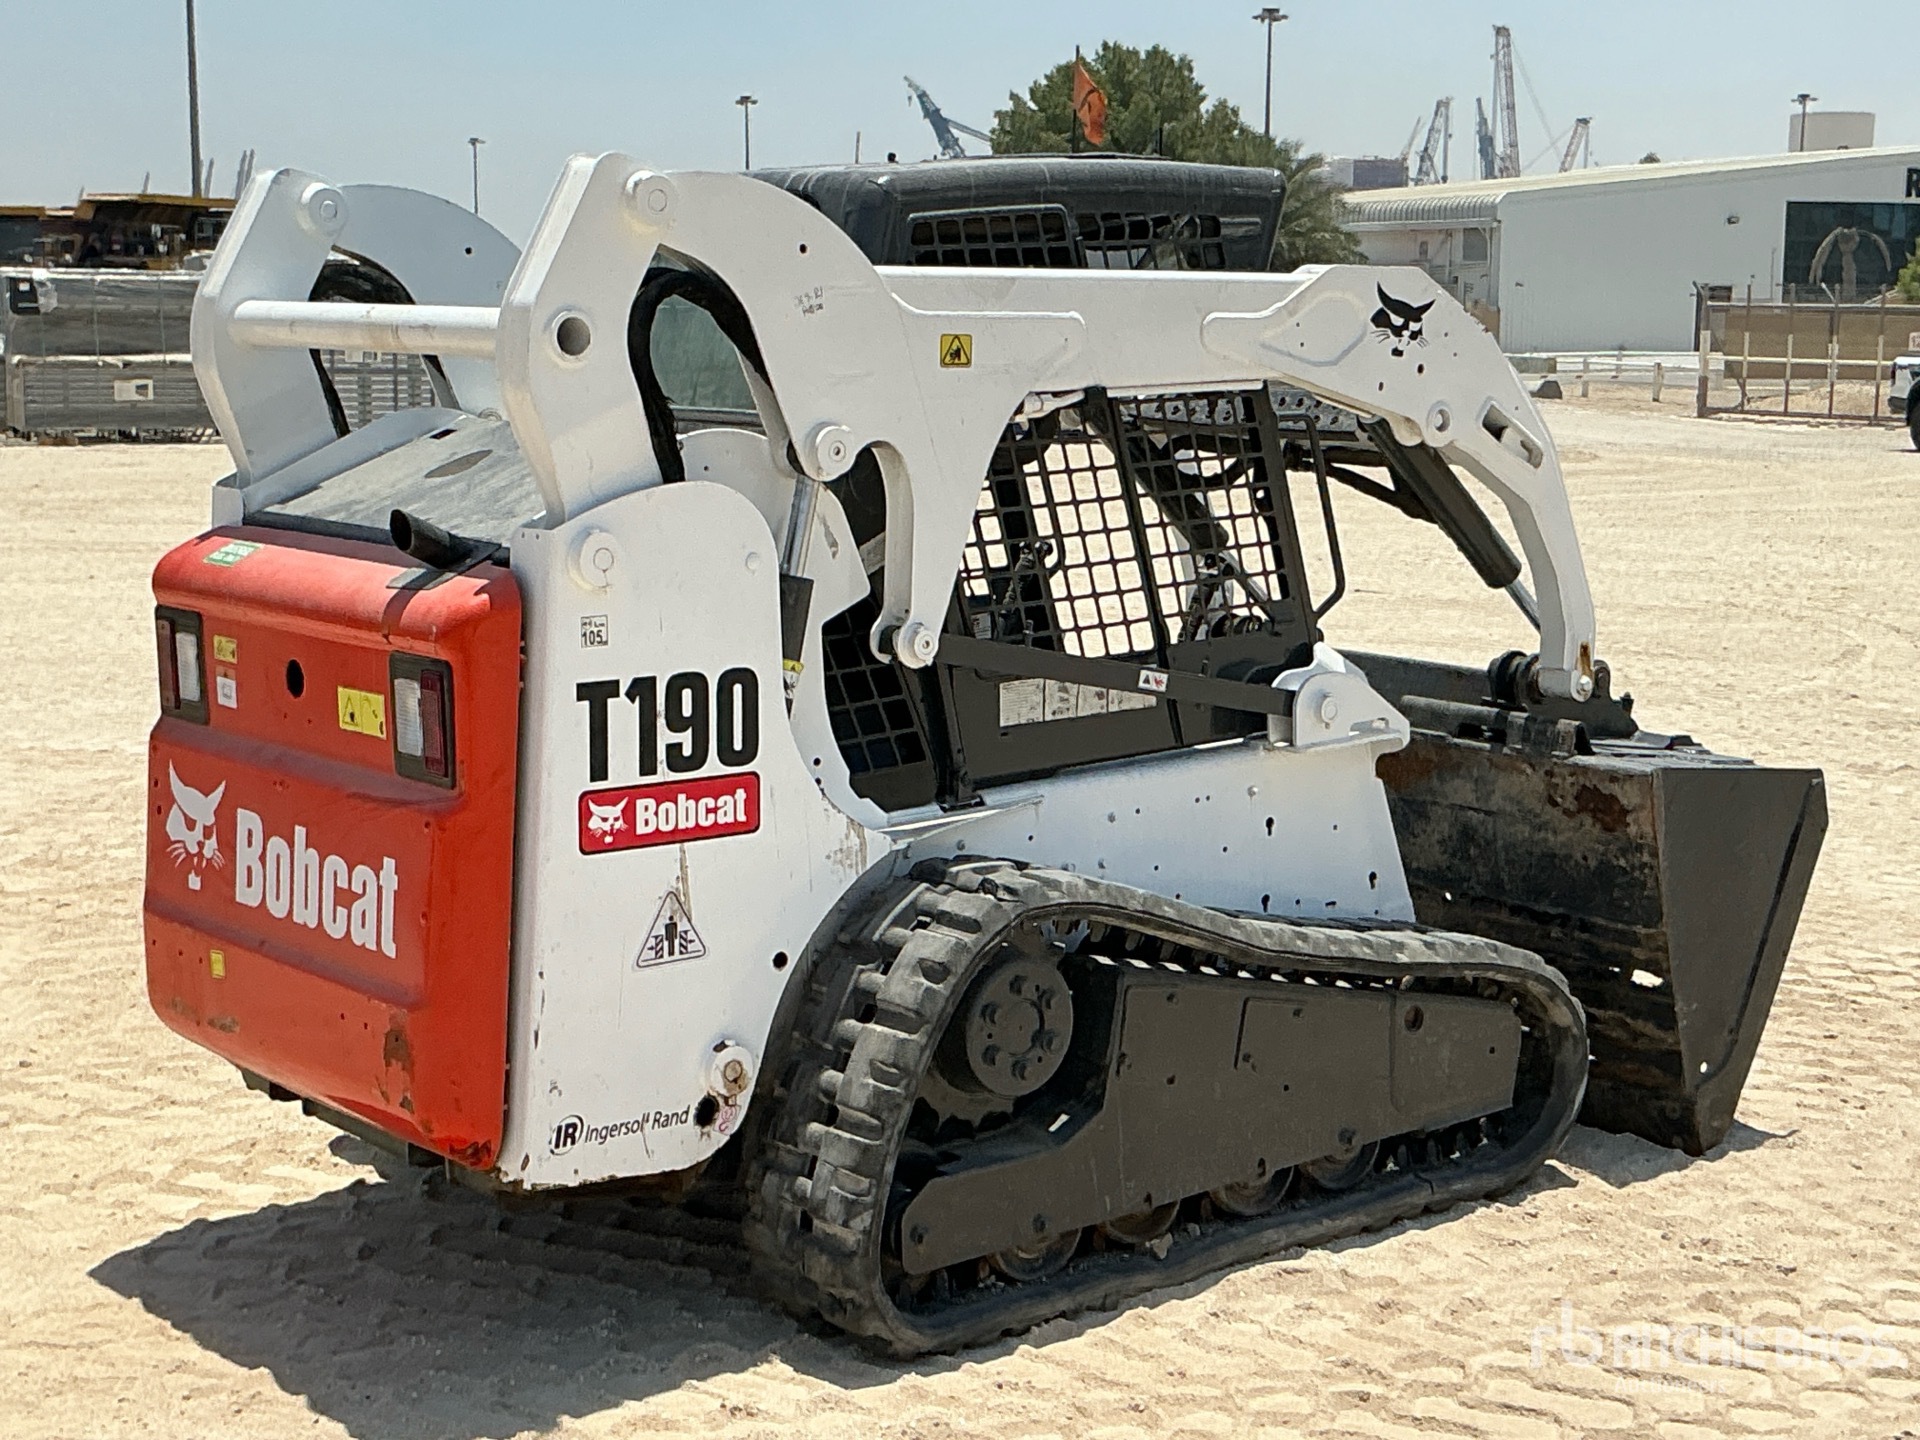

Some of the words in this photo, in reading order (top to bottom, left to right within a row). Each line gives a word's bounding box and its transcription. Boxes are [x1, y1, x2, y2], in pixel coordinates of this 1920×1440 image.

[582, 629, 603, 647] 105
[576, 667, 759, 783] T190
[635, 788, 747, 835] Bobcat
[235, 807, 398, 959] Bobcat
[651, 1104, 691, 1130] Rand
